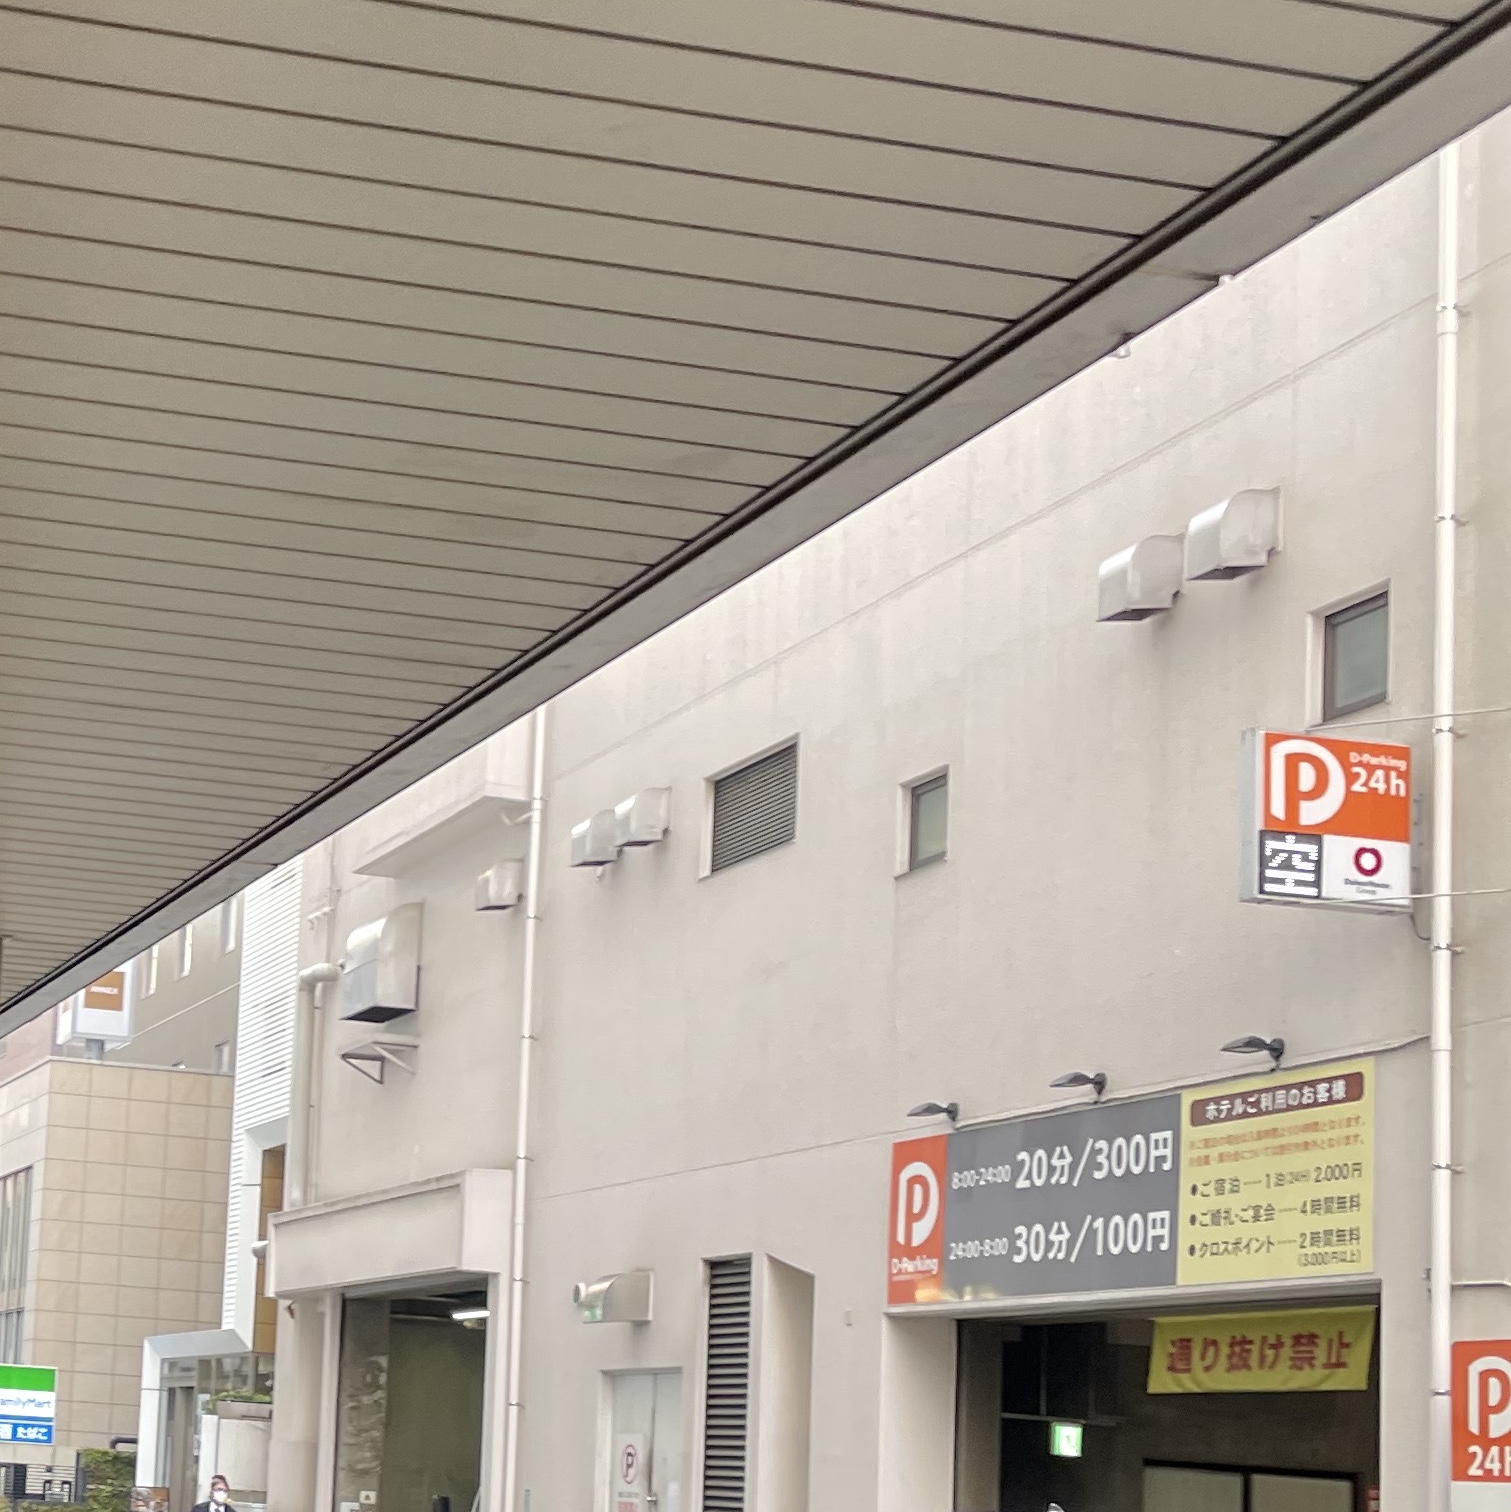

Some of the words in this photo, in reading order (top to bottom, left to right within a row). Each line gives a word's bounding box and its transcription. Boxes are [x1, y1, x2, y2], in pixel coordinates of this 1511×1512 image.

[1350, 766, 1407, 797] 24h
[1264, 835, 1319, 896] 空
[1205, 1078, 1346, 1120] ホテルご利用のお客様
[1015, 1130, 1173, 1189] 20分/300円
[1011, 1210, 1171, 1264] 30分/100円
[1199, 1235, 1276, 1259] クロスポイント
[1167, 1331, 1353, 1375] 通り抜け禁止
